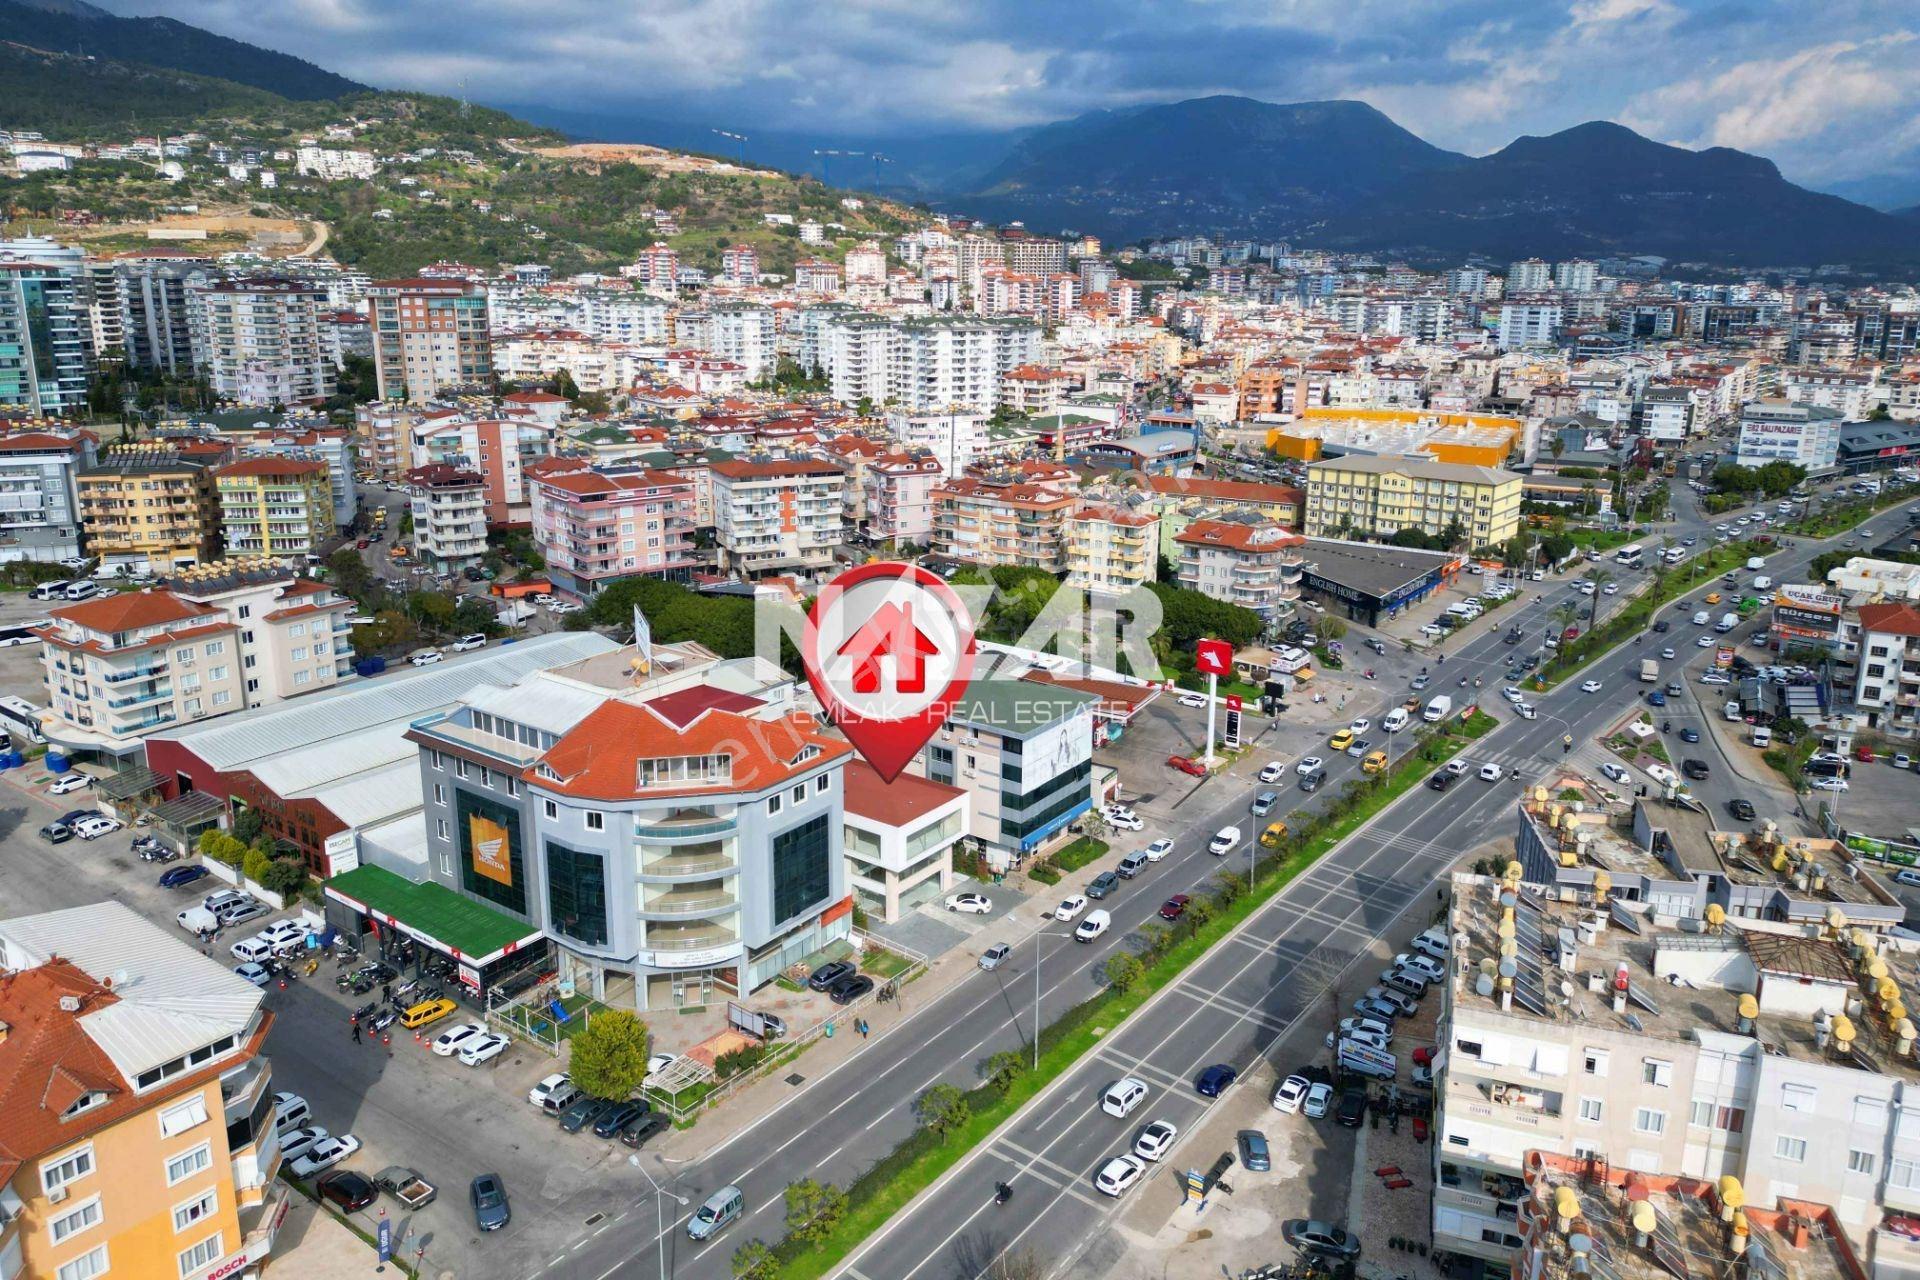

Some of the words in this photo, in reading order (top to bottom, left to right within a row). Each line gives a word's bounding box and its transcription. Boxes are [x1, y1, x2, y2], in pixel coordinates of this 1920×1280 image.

[1309, 575, 1337, 594] ENGLISH
[1337, 586, 1360, 602] HOME
[1815, 594, 1841, 604] GRUP
[478, 854, 506, 872] HONDA
[207, 1254, 247, 1280] BOSCH
